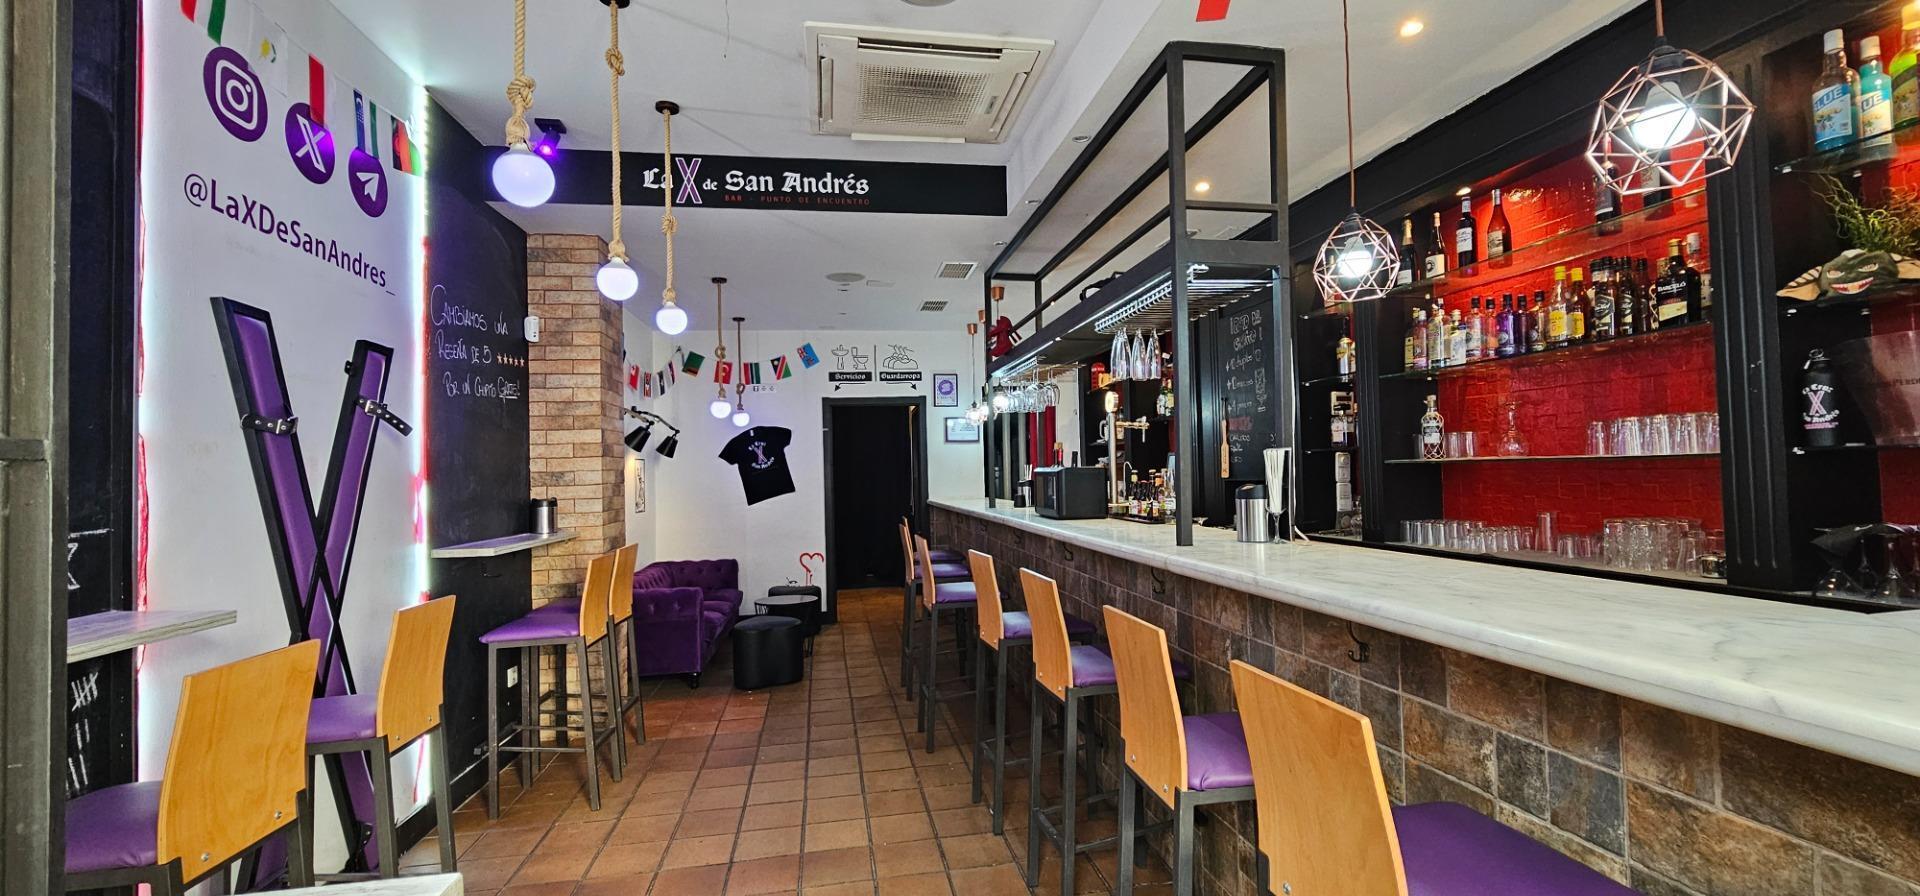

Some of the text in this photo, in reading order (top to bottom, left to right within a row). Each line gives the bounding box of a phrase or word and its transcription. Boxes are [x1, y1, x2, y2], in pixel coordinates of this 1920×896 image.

[703, 178, 718, 191] de
[725, 170, 774, 192] San
[782, 171, 870, 195] Andrés
[725, 194, 742, 202] BAR
[760, 195, 791, 204] PUNTO
[798, 196, 809, 204] DE
[817, 197, 870, 206] ENCUENTRO
[184, 173, 396, 297] @LaXDeSanAndres_
[482, 345, 492, 364] 5
[881, 373, 921, 381] Guardarropa
